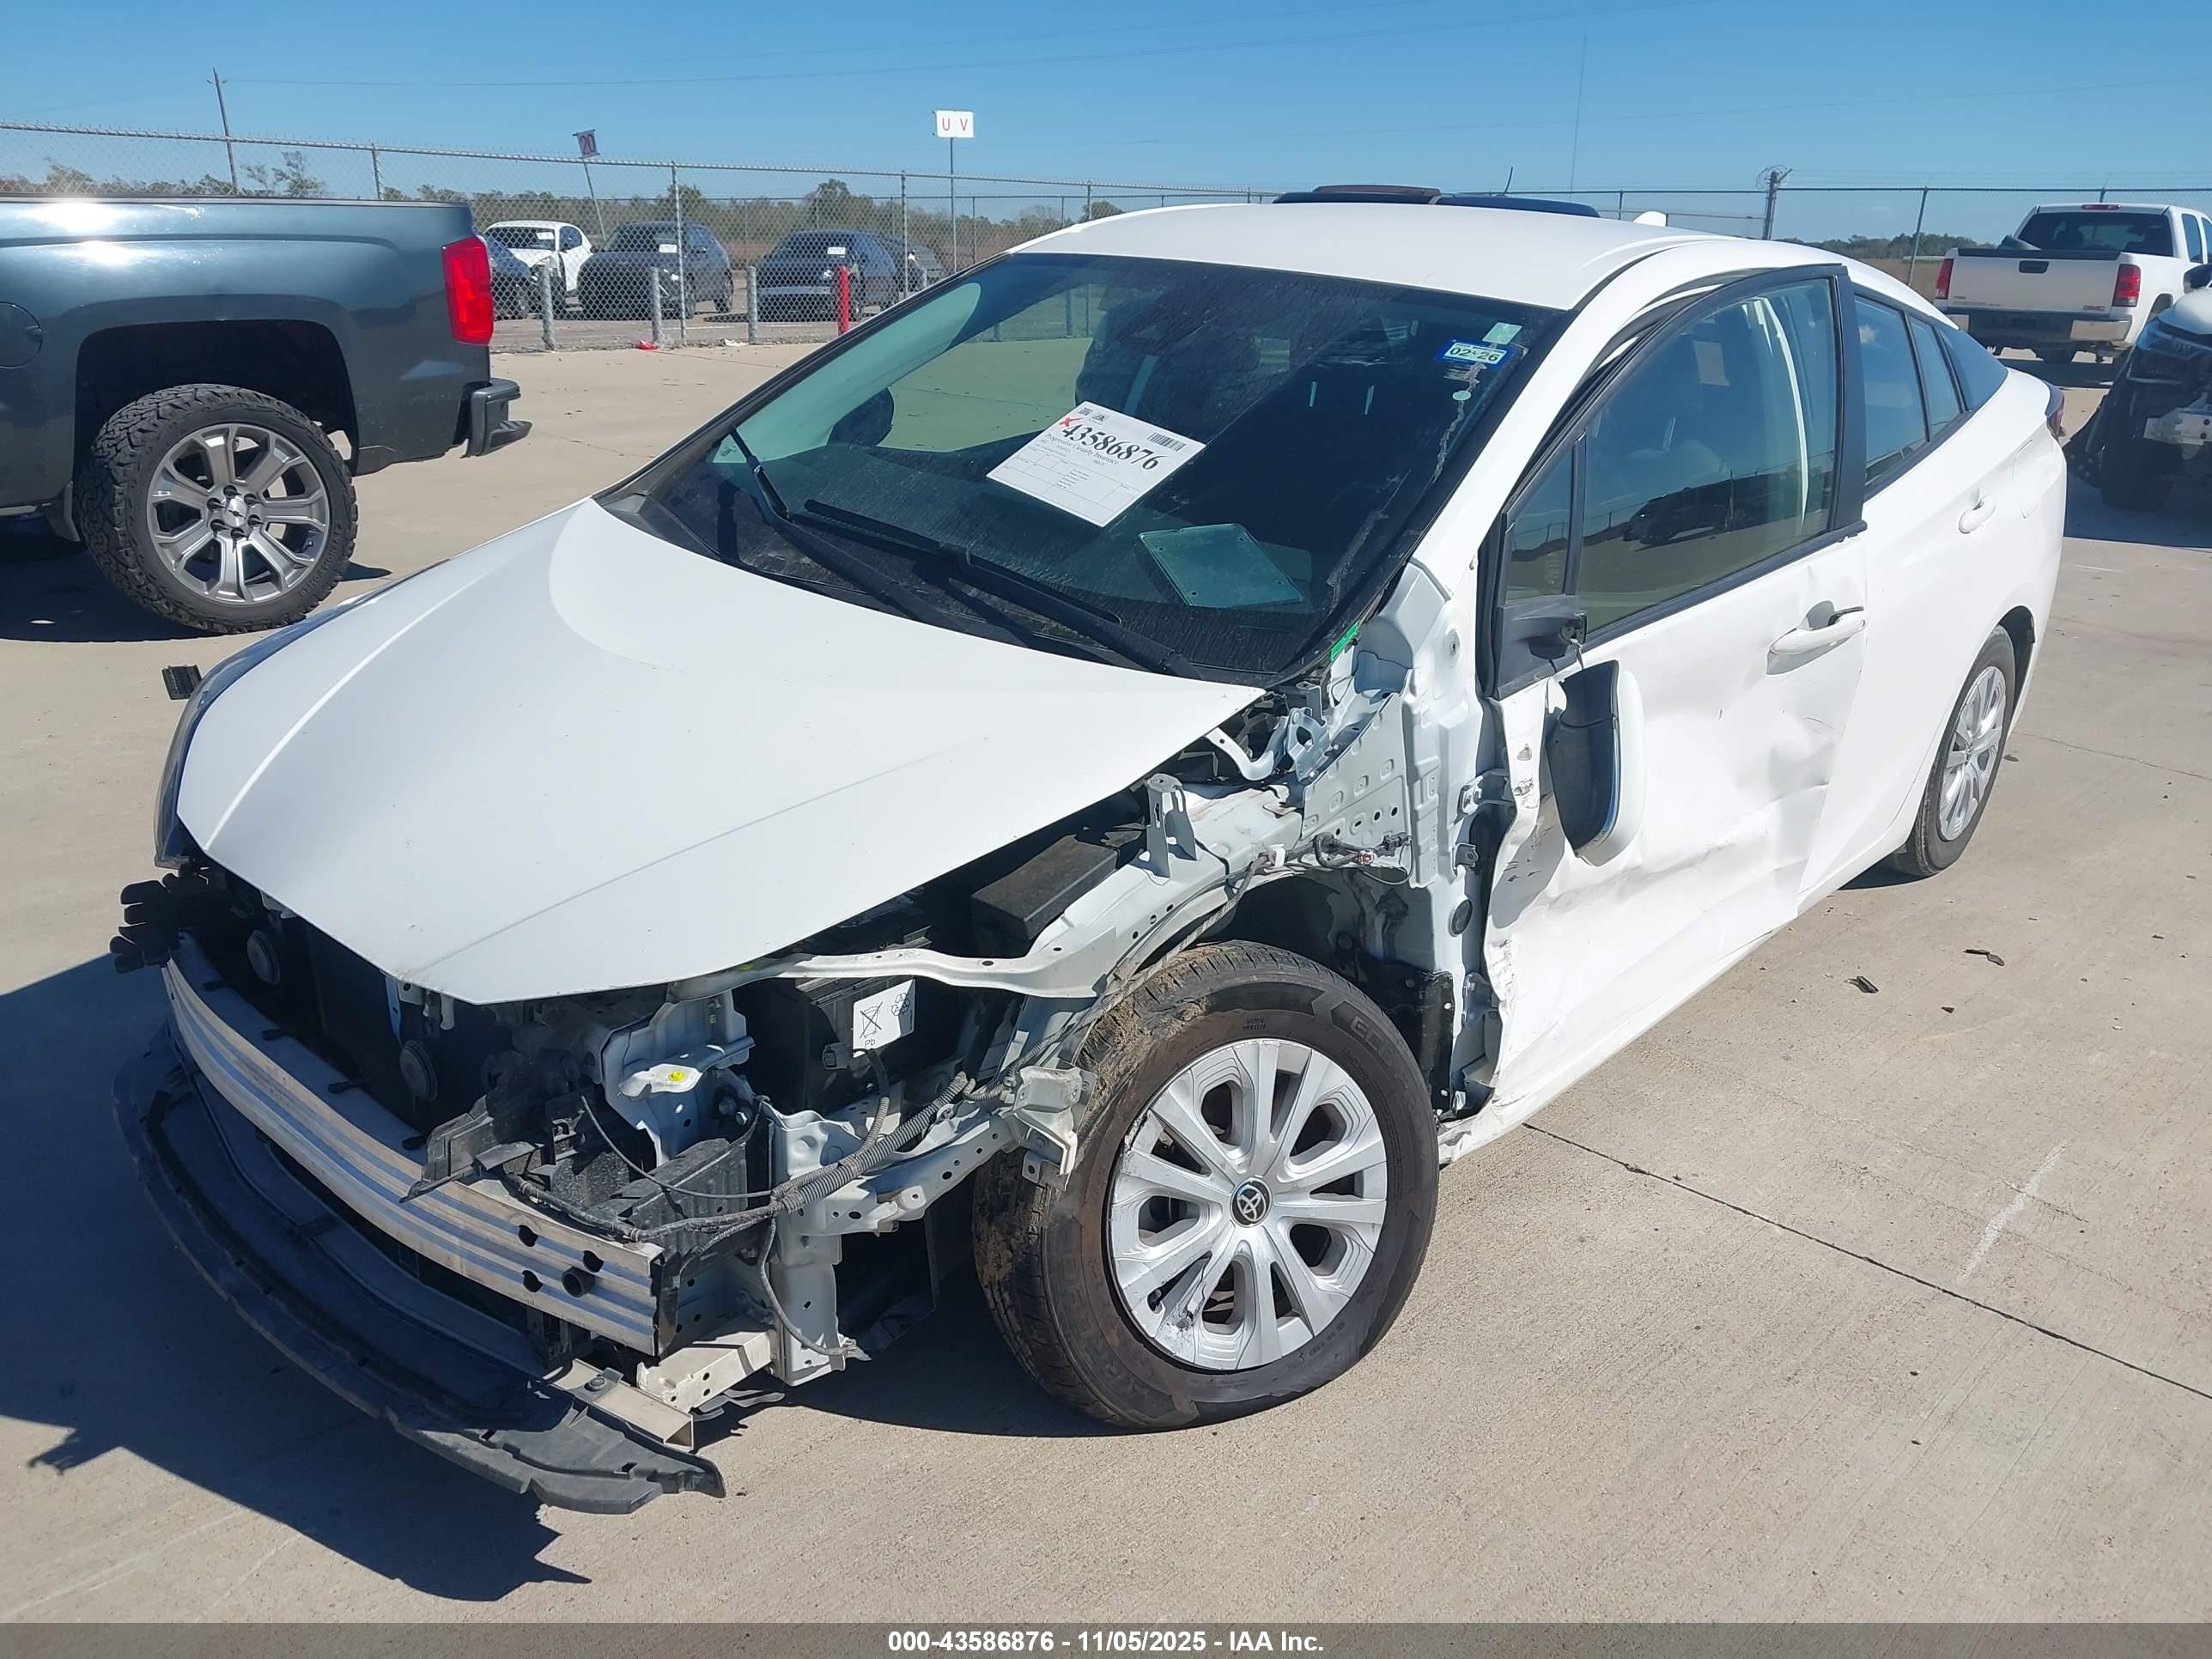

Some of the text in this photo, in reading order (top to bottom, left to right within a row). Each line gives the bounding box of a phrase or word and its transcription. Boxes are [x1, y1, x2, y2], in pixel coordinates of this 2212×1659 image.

[942, 117, 968, 131] U V
[580, 133, 596, 155] 20
[1450, 348, 1499, 362] 02 26
[1062, 424, 1169, 471] 43586876
[865, 1037, 876, 1048] Pb
